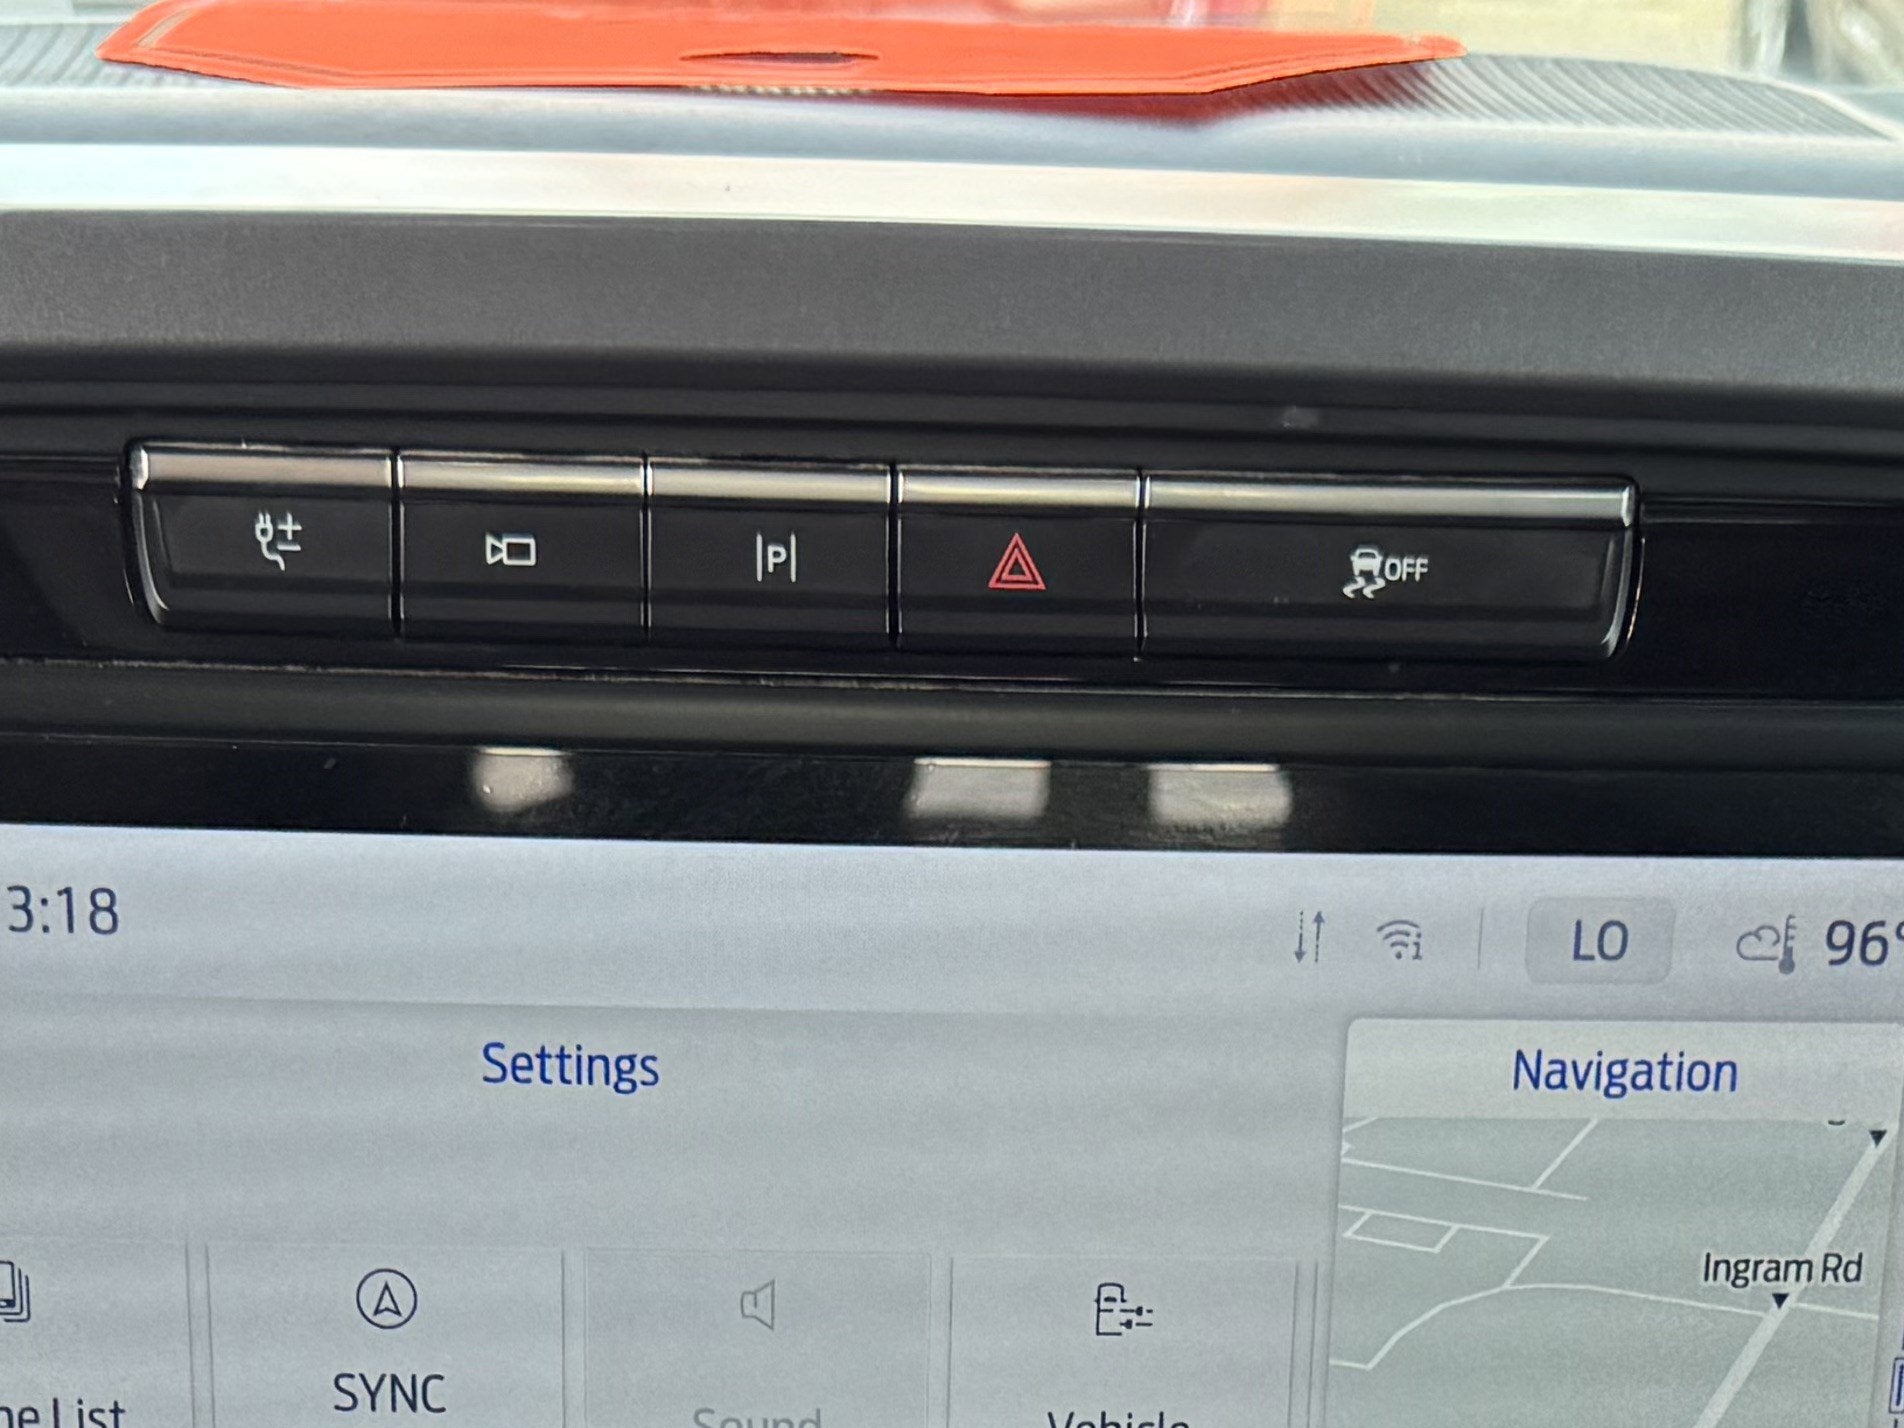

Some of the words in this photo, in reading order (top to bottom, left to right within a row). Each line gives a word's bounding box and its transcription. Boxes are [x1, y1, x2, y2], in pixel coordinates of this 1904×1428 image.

[1383, 556, 1429, 582] OFF
[7, 884, 119, 936] 3:18
[1572, 919, 1629, 962] LO
[482, 1041, 660, 1095] Settings
[1513, 1048, 1738, 1100] Navigation
[1703, 1249, 1812, 1286] Ingram
[1820, 1252, 1863, 1283] Rd
[333, 1372, 447, 1414] SYNC
